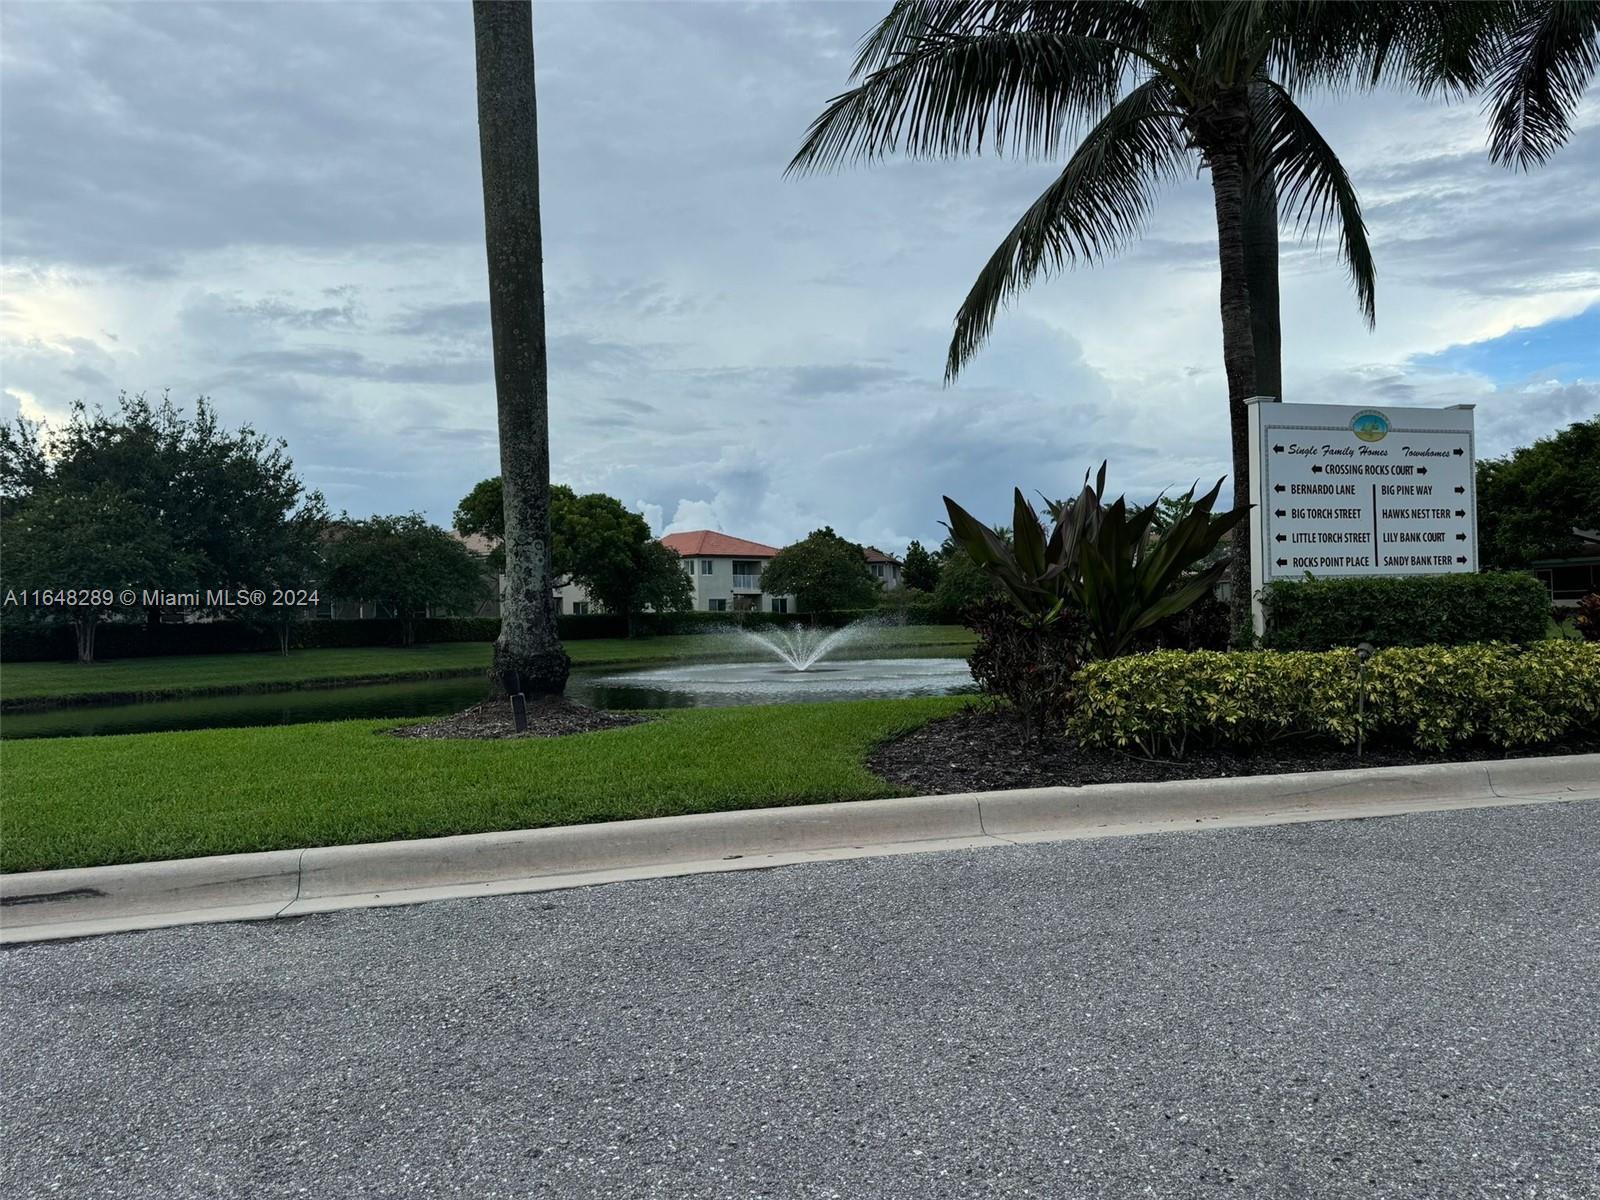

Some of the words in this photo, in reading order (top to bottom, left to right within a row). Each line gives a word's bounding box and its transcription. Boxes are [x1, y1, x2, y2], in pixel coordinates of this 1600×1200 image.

[1288, 443, 1318, 458] Single
[1321, 444, 1354, 458] Family
[1358, 444, 1389, 457] Homes
[1401, 445, 1450, 458] Townhomes
[1325, 463, 1363, 475] CROSSING
[1364, 464, 1389, 475] ROCKS
[1391, 465, 1414, 476] COURT
[1291, 484, 1334, 495] BERNARDO
[1336, 484, 1356, 495] LANE
[1381, 484, 1395, 495] BIG
[1396, 485, 1415, 495] PINE
[1415, 485, 1433, 495] WAY
[1291, 508, 1305, 519] BIG
[1307, 508, 1333, 519] TORCH
[1334, 508, 1361, 519] STREET
[1382, 508, 1410, 519] HAWKS
[1411, 508, 1431, 519] NEST
[1431, 508, 1451, 519] TERR
[1292, 532, 1317, 543] LITTLE
[1318, 532, 1343, 543] TORCH
[1344, 532, 1371, 543] STREET
[1383, 532, 1399, 543] LILY
[1400, 532, 1421, 543] BANK
[1422, 532, 1446, 542] COURT
[1293, 556, 1319, 567] ROCKS
[1320, 556, 1344, 567] POINT
[1345, 556, 1370, 567] PLACE
[1384, 556, 1410, 567] SANDY
[1411, 555, 1432, 566] BANK
[1433, 555, 1453, 566] TERR
